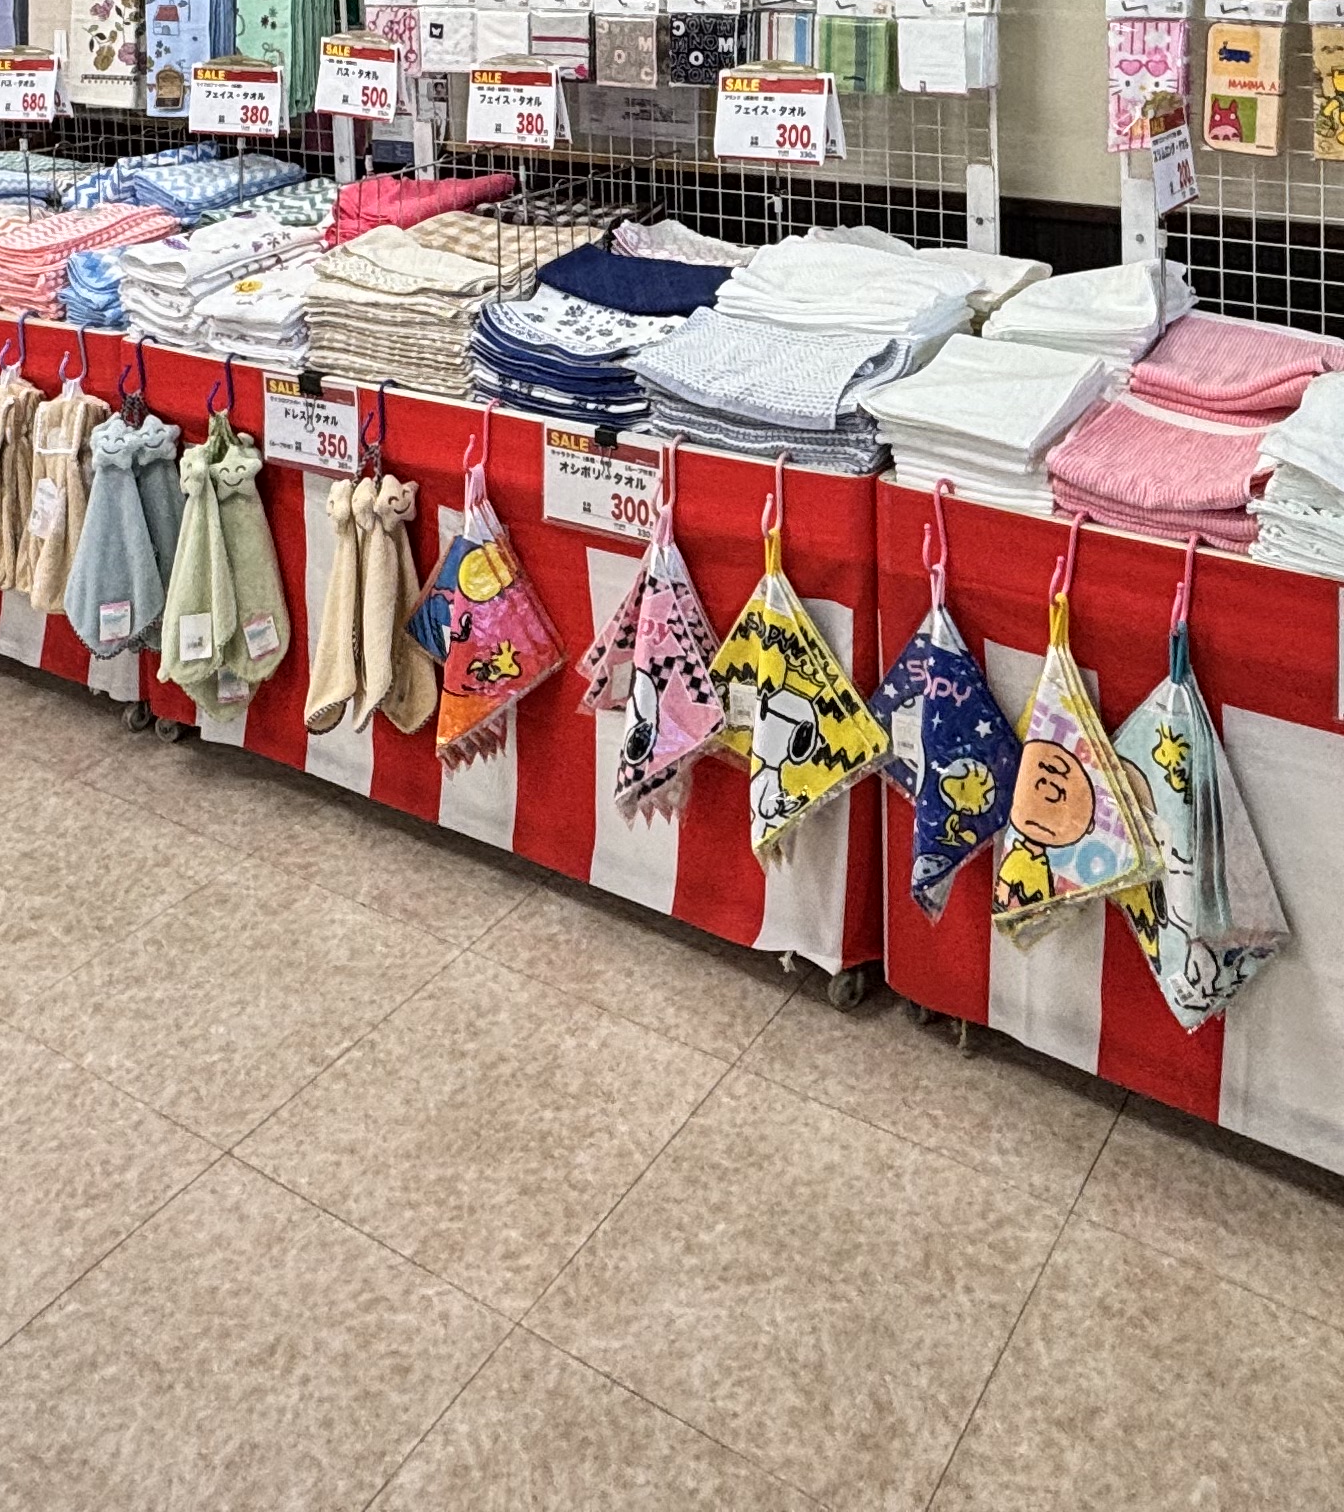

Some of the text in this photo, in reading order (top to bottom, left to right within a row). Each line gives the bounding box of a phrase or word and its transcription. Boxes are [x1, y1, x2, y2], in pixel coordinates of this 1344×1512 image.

[325, 44, 351, 56] SALE
[197, 70, 225, 80] SALE
[474, 71, 502, 83] SALE
[724, 78, 760, 91] SALE
[205, 90, 265, 100] フェイス・タオル
[479, 94, 542, 107] フェイス・タオル
[734, 104, 806, 117] フェイス・タオル
[269, 380, 301, 396] SALE
[284, 408, 338, 426] ドレスタオル
[550, 432, 589, 452] SALE
